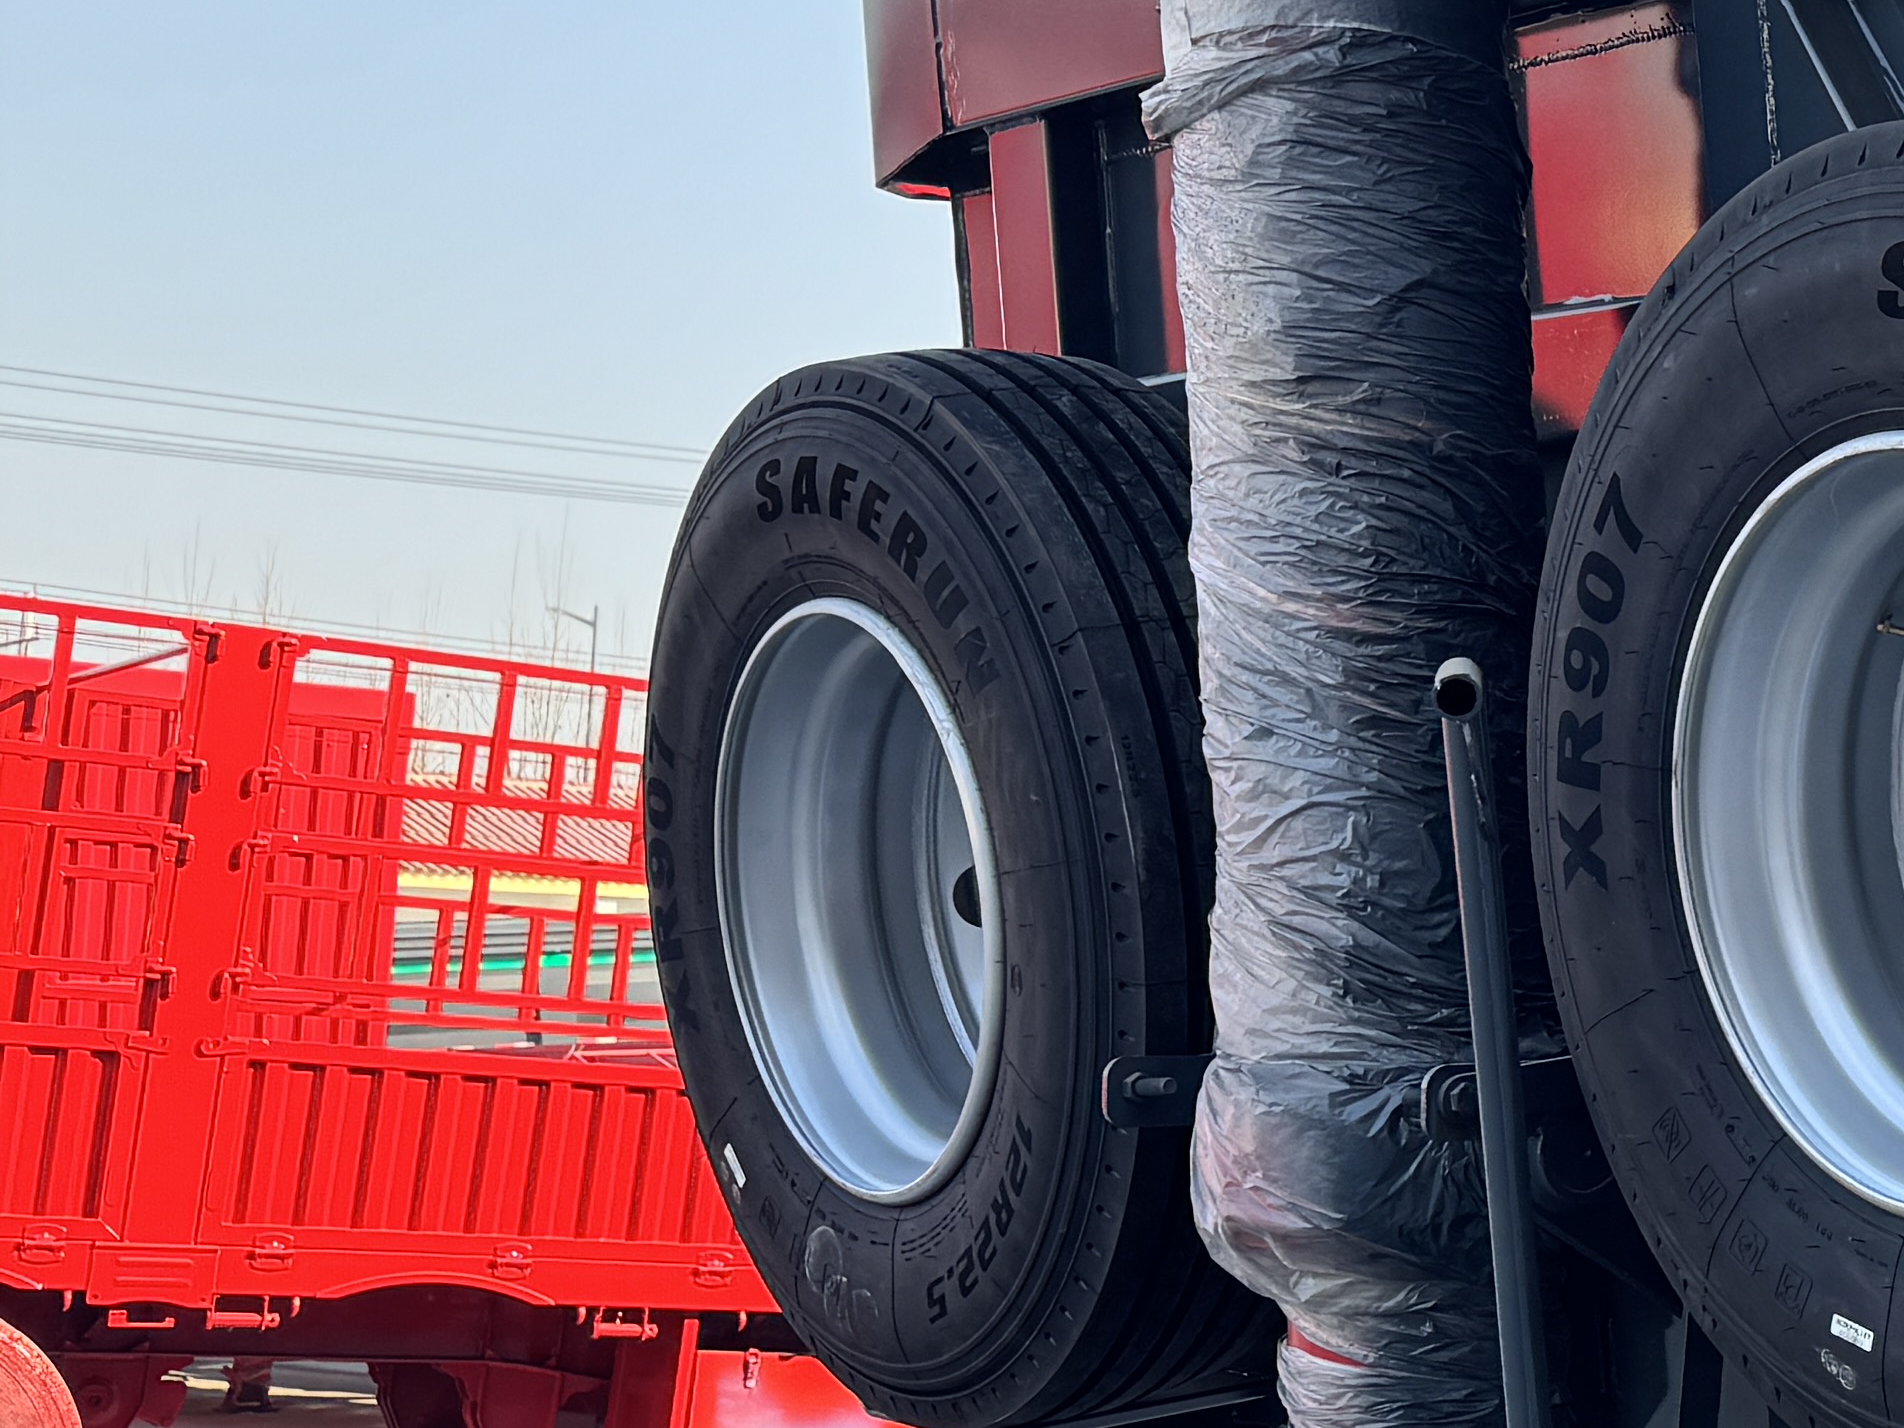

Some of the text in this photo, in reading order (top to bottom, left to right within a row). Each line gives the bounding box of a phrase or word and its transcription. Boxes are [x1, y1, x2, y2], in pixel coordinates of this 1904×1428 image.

[755, 456, 1001, 696] SAFERUN
[1556, 472, 1658, 893] XR907
[645, 714, 702, 1034] XR907
[926, 1119, 1036, 1326] 12R22.5
